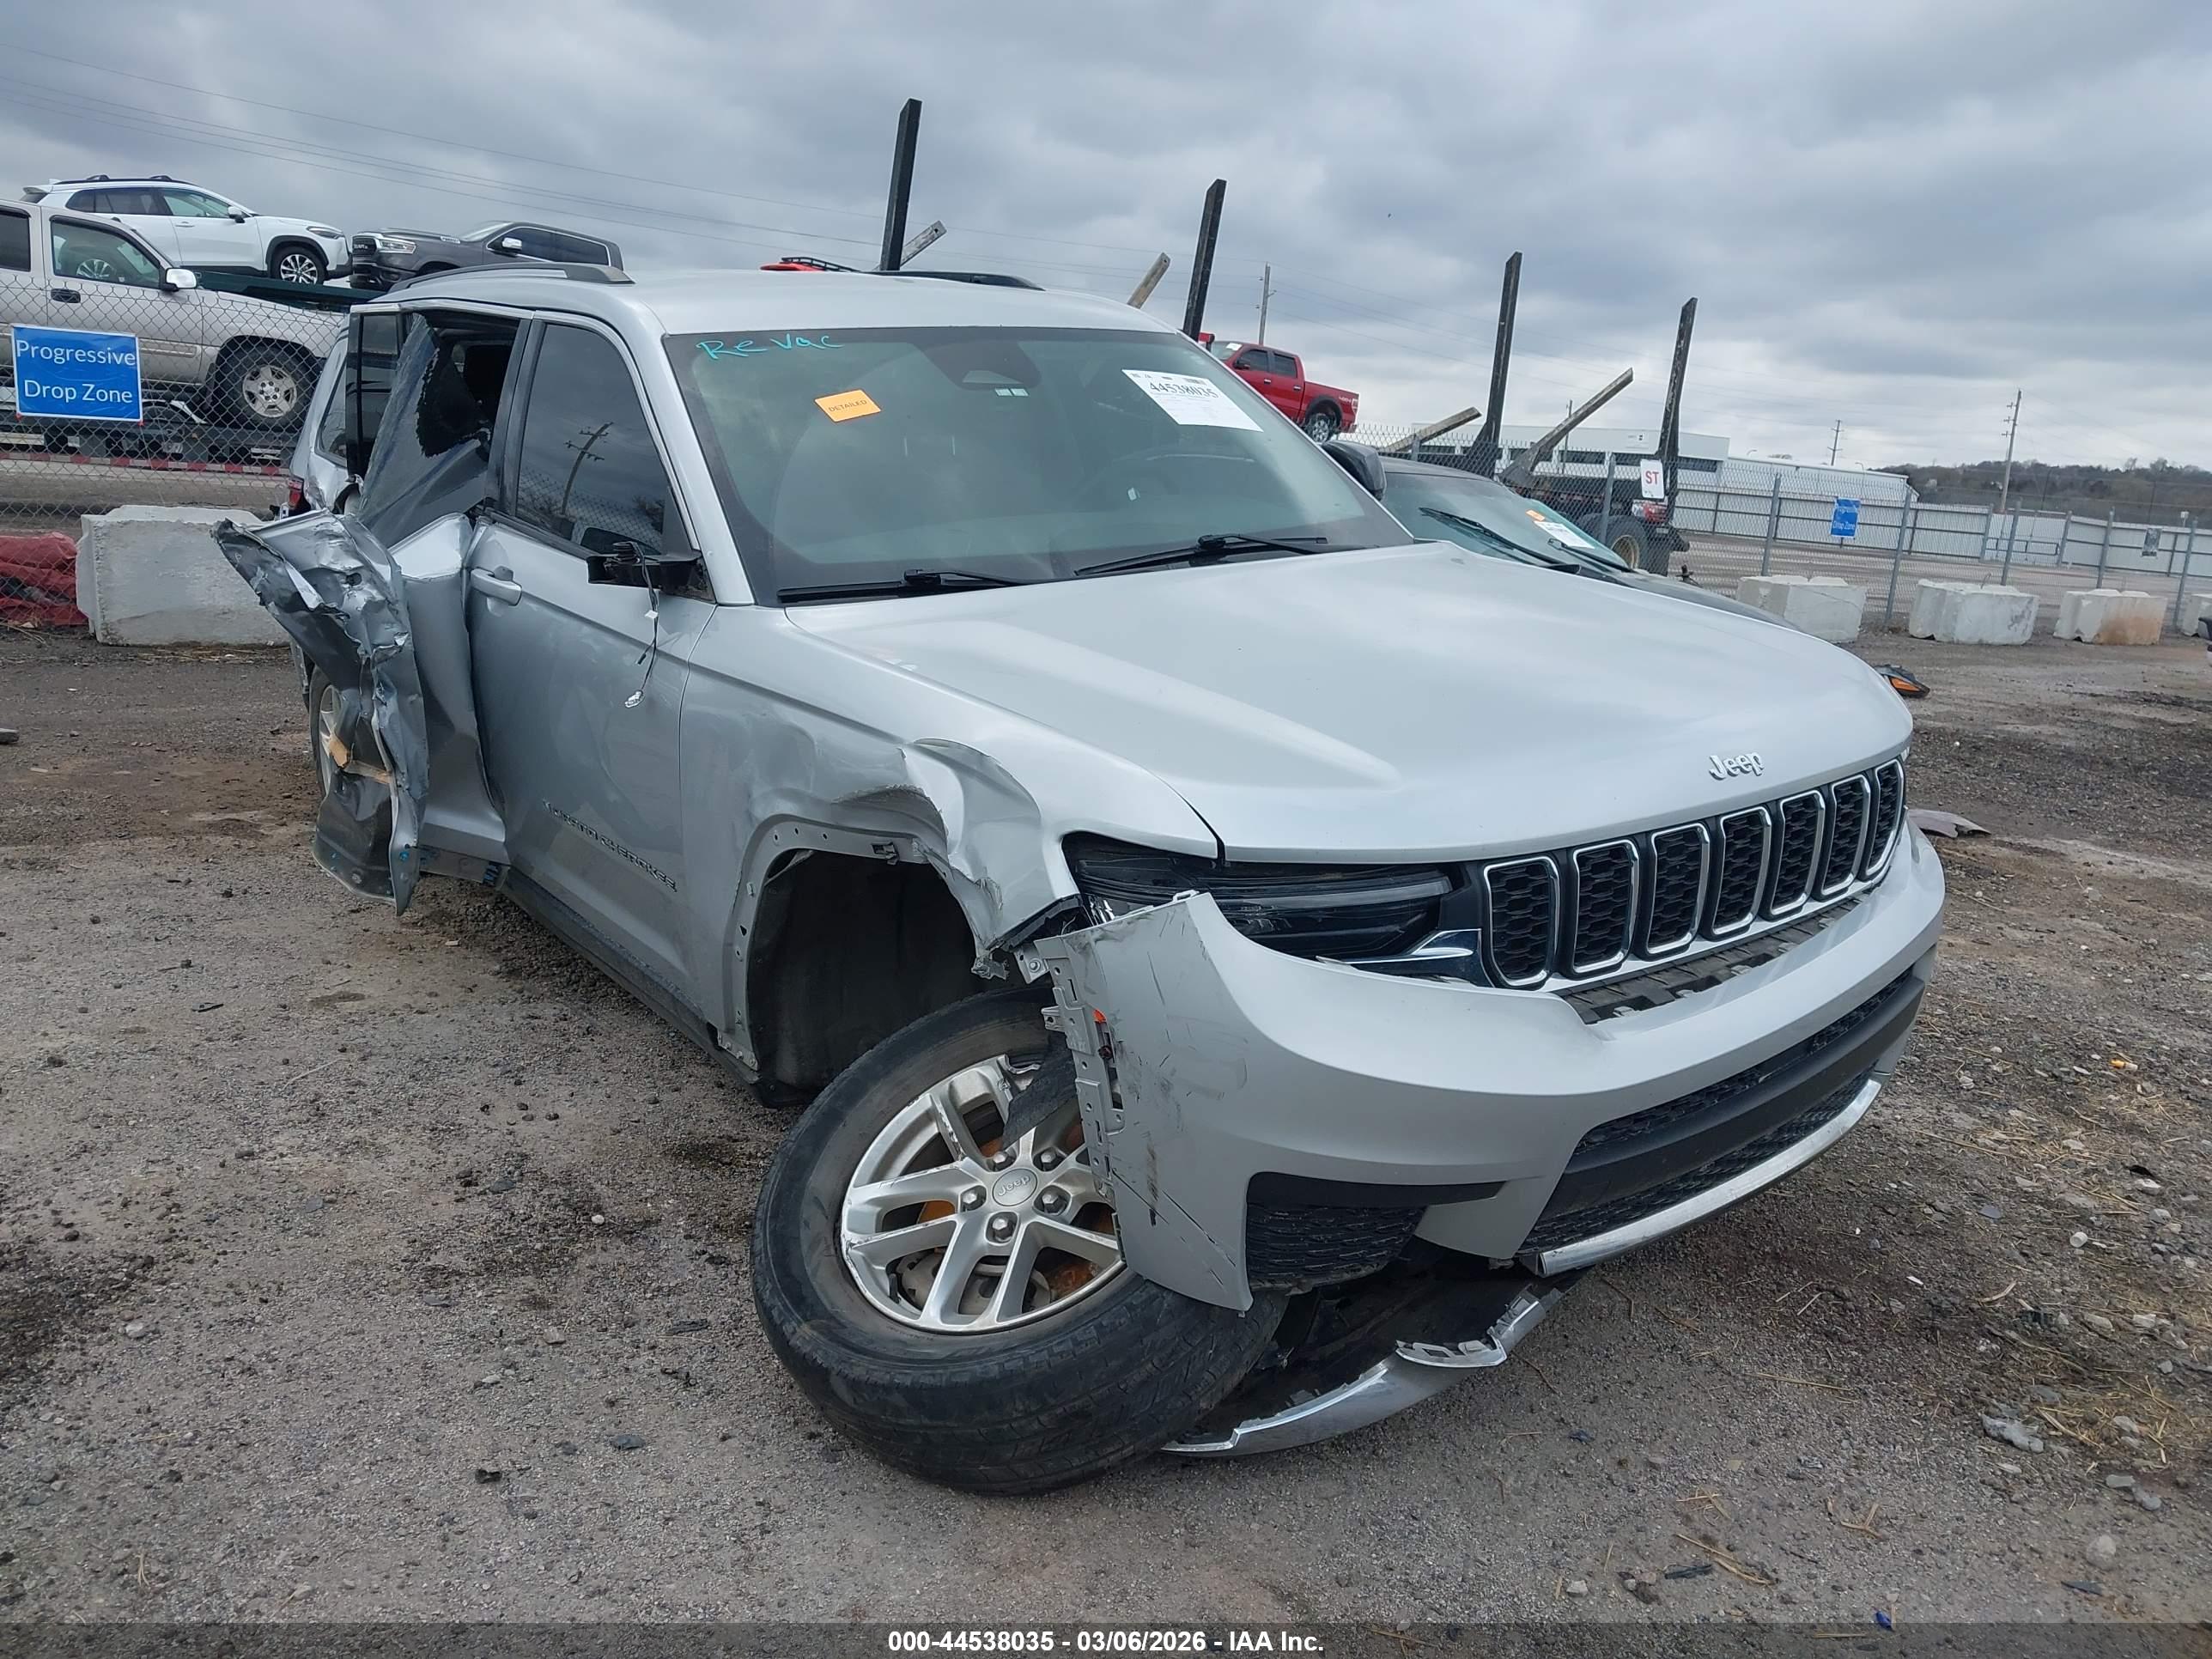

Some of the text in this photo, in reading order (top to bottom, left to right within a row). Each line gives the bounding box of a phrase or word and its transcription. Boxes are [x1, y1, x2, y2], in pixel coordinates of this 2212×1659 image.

[15, 339, 136, 366] Progressive
[24, 380, 133, 404] Drop Zone
[1150, 383, 1219, 398] 44538035
[828, 399, 867, 412] DETAILED
[1645, 470, 1659, 485] ST
[1709, 752, 1765, 781] Jeep
[998, 1176, 1030, 1196] Jeep
